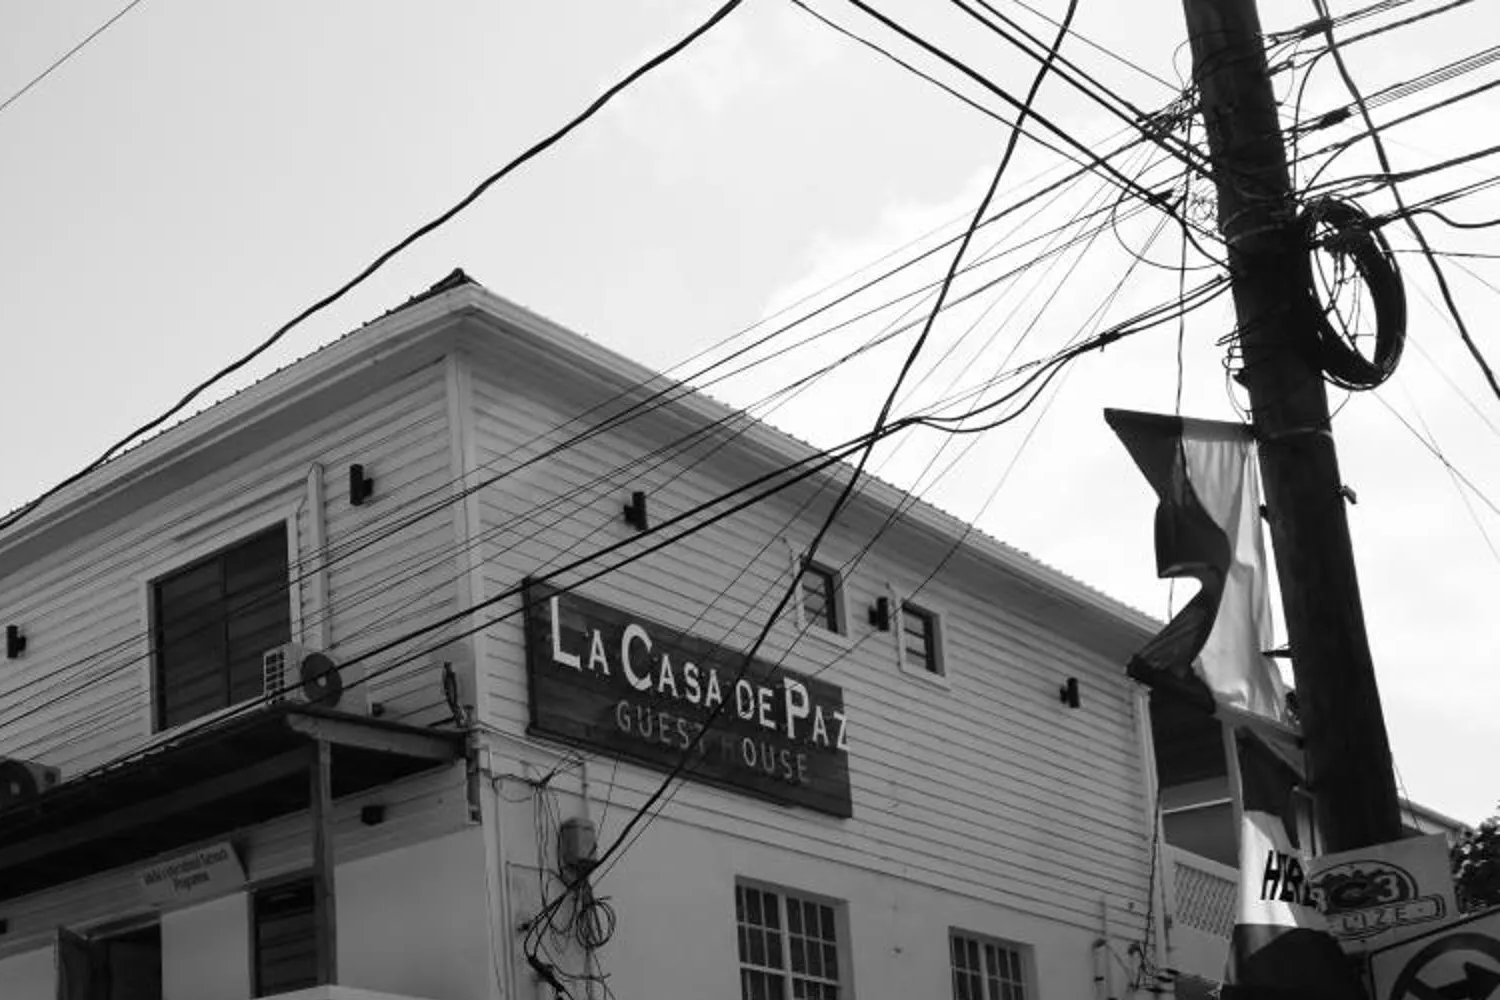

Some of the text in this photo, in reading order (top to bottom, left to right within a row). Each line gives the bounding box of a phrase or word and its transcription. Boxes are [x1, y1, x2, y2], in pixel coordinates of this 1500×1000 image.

[551, 595, 849, 752] LA CASA DE PAZ
